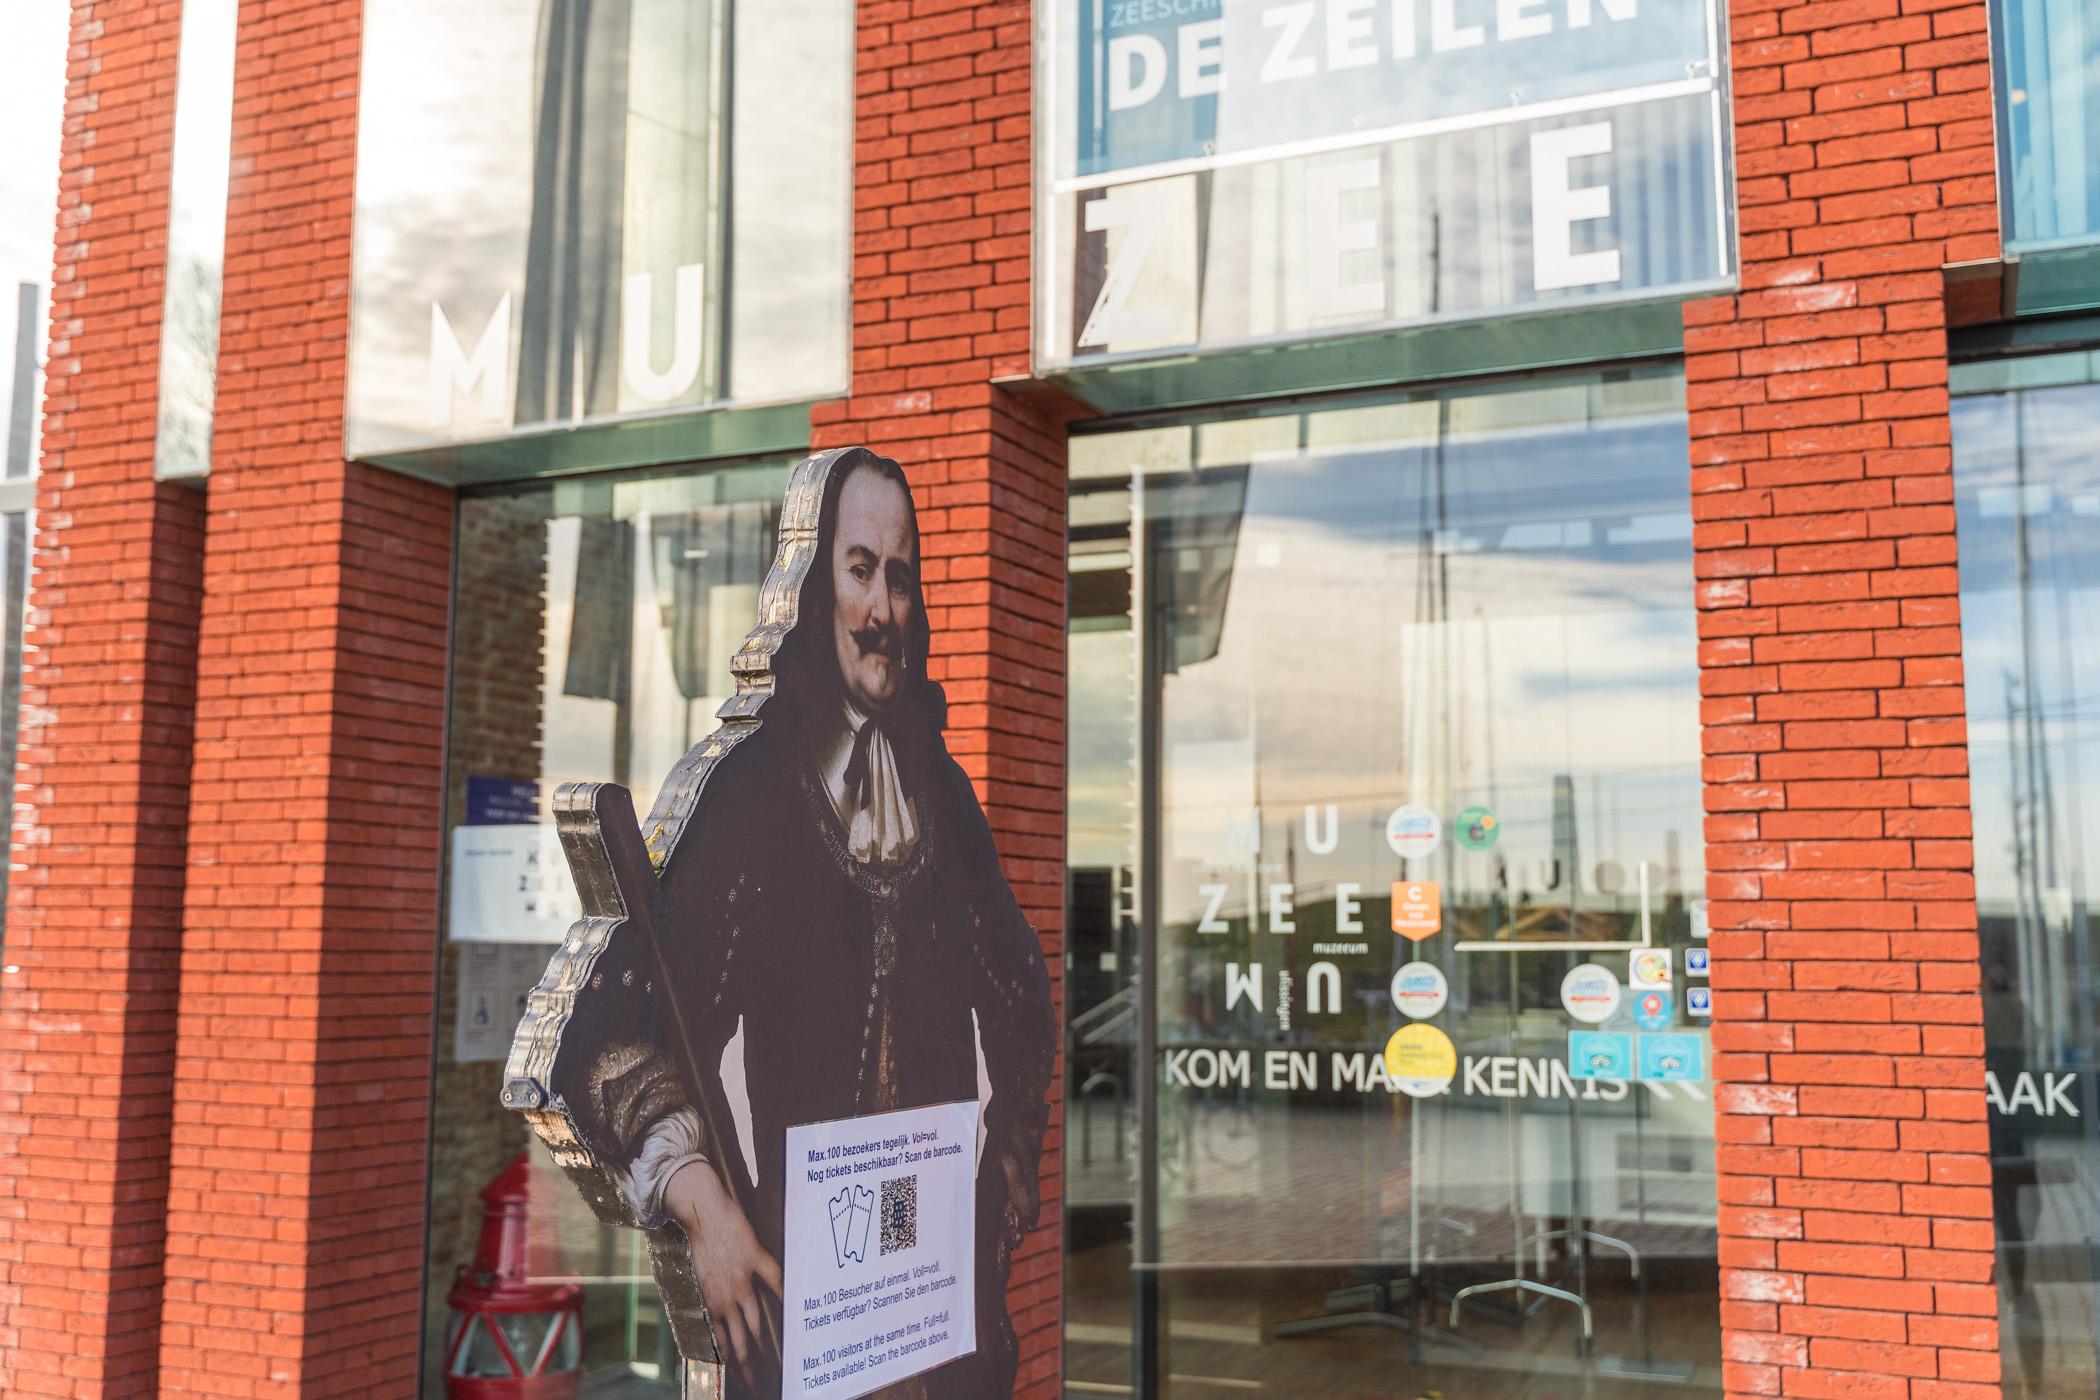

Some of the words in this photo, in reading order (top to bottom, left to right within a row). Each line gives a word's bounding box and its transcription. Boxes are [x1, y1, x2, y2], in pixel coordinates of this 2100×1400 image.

[1108, 17, 1228, 112] DE
[1165, 1048, 1250, 1089] KOM
[1265, 1051, 1318, 1091] EN
[1332, 1052, 1451, 1096] MA
[807, 1169, 824, 1183] Nog
[826, 1162, 851, 1179] tickets
[854, 1153, 903, 1174] beschikbaar?
[904, 1149, 922, 1163] Scan
[923, 1147, 932, 1159] de
[933, 1142, 963, 1158] barcode.
[843, 1140, 881, 1157] bezoekers
[882, 1135, 910, 1151] tegelijk.
[912, 1129, 939, 1145] Vol=vol.
[803, 1313, 831, 1331] Tickets
[832, 1298, 872, 1320] verfügbar?
[873, 1291, 903, 1310] Scannen
[904, 1285, 916, 1299] Sie
[917, 1281, 930, 1295] den
[930, 1274, 958, 1291] barcode.
[838, 1282, 873, 1301] Besucher
[874, 1276, 886, 1290] auf
[887, 1269, 910, 1287] einmal.
[912, 1261, 941, 1279] Voll=voll.
[837, 1341, 864, 1359] visitors
[865, 1338, 873, 1350] at
[873, 1332, 885, 1347] the
[886, 1327, 905, 1343] same
[906, 1321, 923, 1335] time.
[924, 1310, 951, 1330] Full=full.
[803, 1372, 831, 1391] Tickets
[832, 1359, 867, 1380] available!
[868, 1353, 887, 1368] Scan
[888, 1347, 899, 1361] the
[900, 1337, 927, 1357] barcode
[928, 1329, 950, 1346] above.
